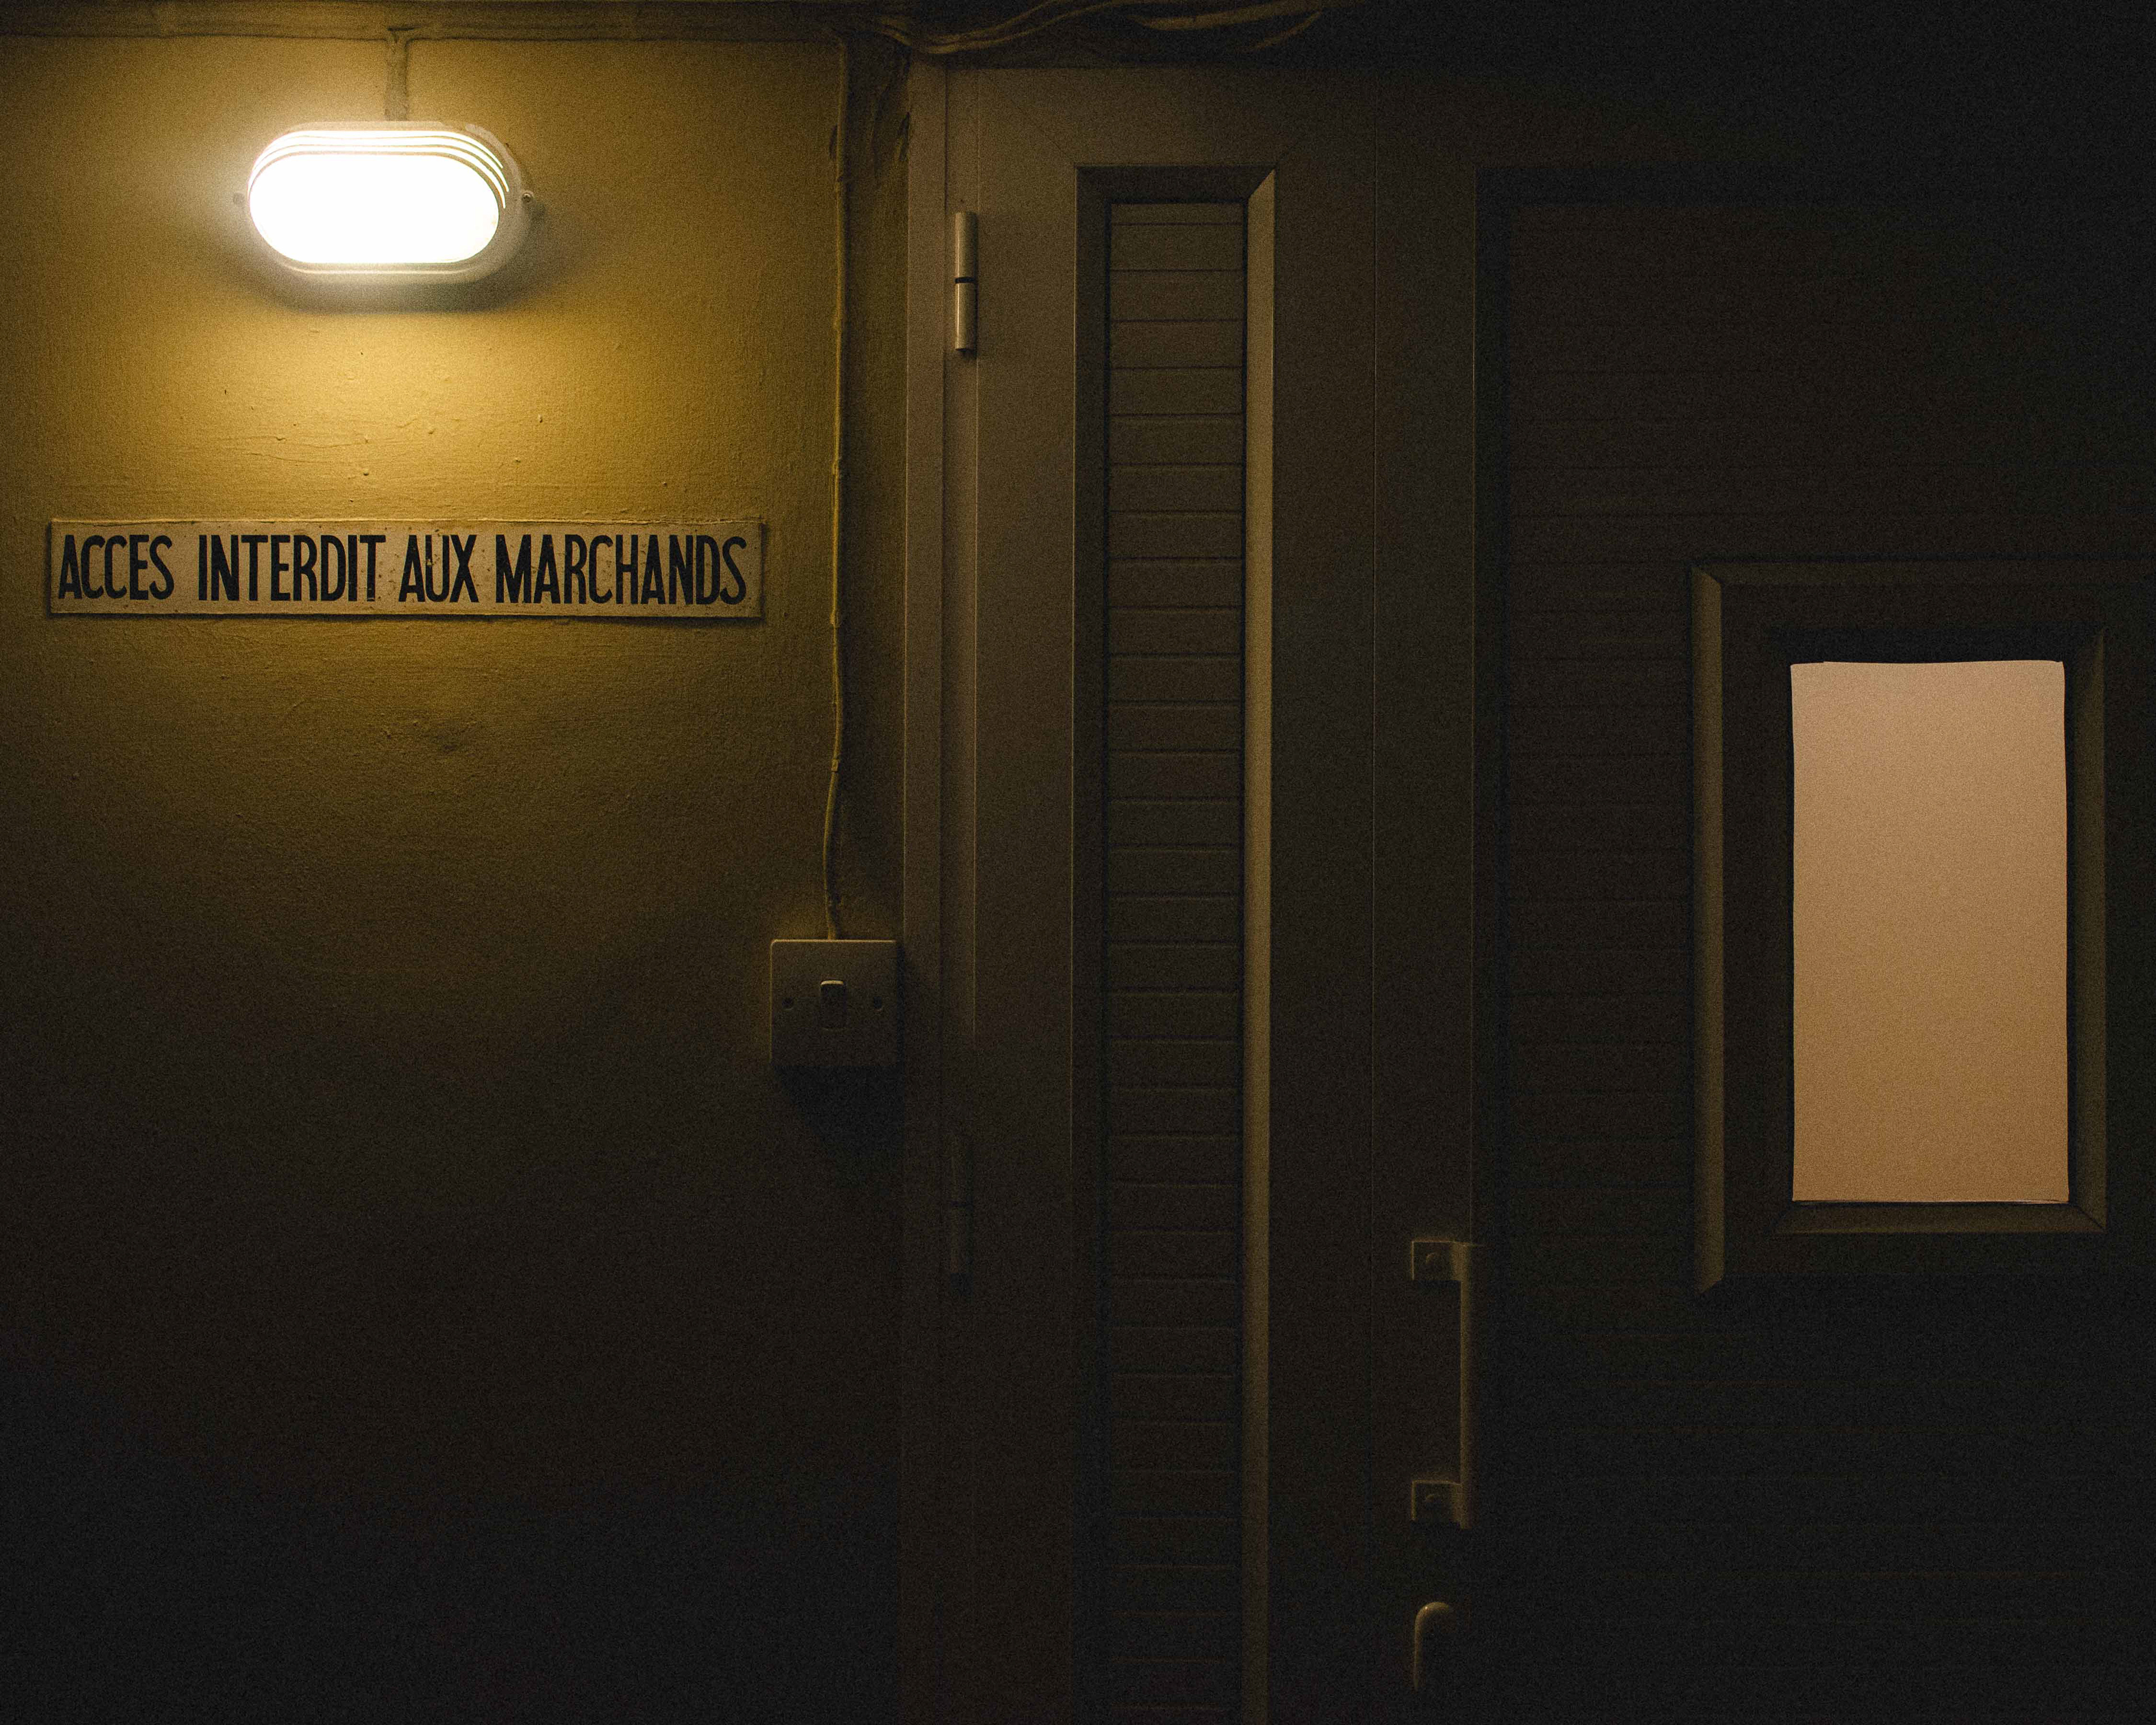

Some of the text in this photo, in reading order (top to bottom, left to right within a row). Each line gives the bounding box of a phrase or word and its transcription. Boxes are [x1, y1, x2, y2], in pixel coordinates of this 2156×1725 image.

[58, 534, 747, 606] ACCES INTERDIT AUX MARCHANDS
